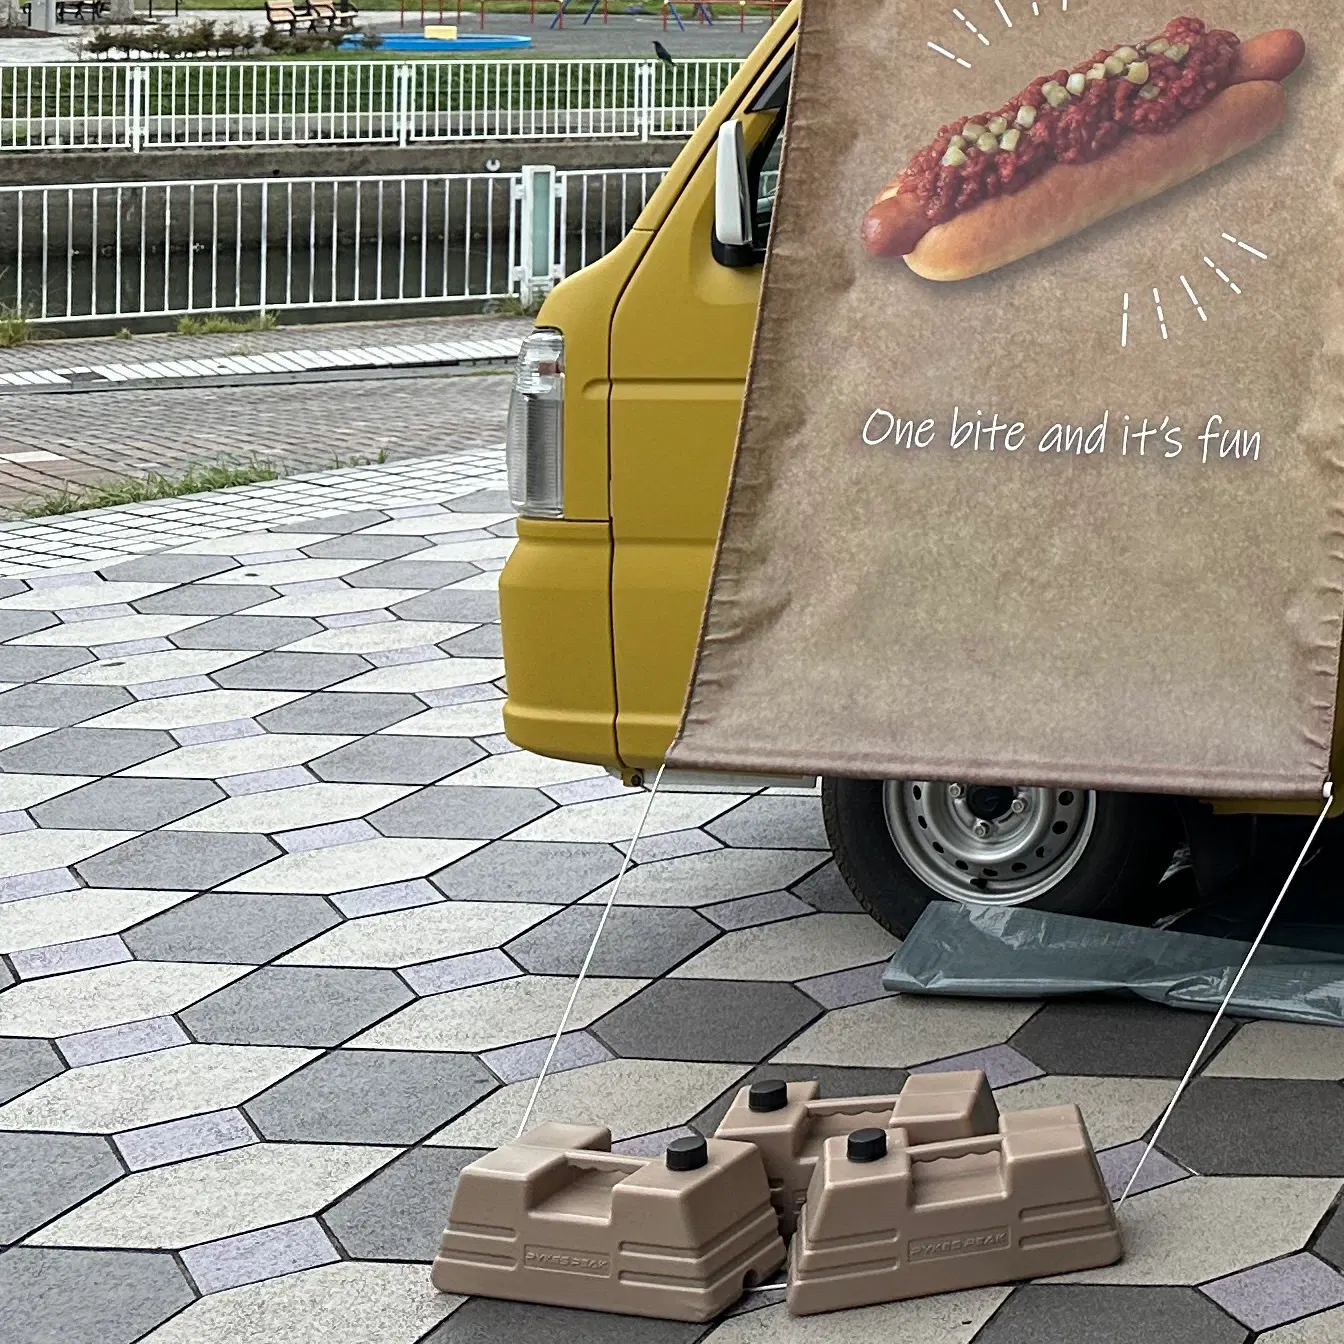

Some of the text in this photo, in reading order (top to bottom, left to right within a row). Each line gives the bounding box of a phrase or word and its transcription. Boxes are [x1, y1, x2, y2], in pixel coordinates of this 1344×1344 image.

[862, 406, 1261, 463] One bite and it's fun
